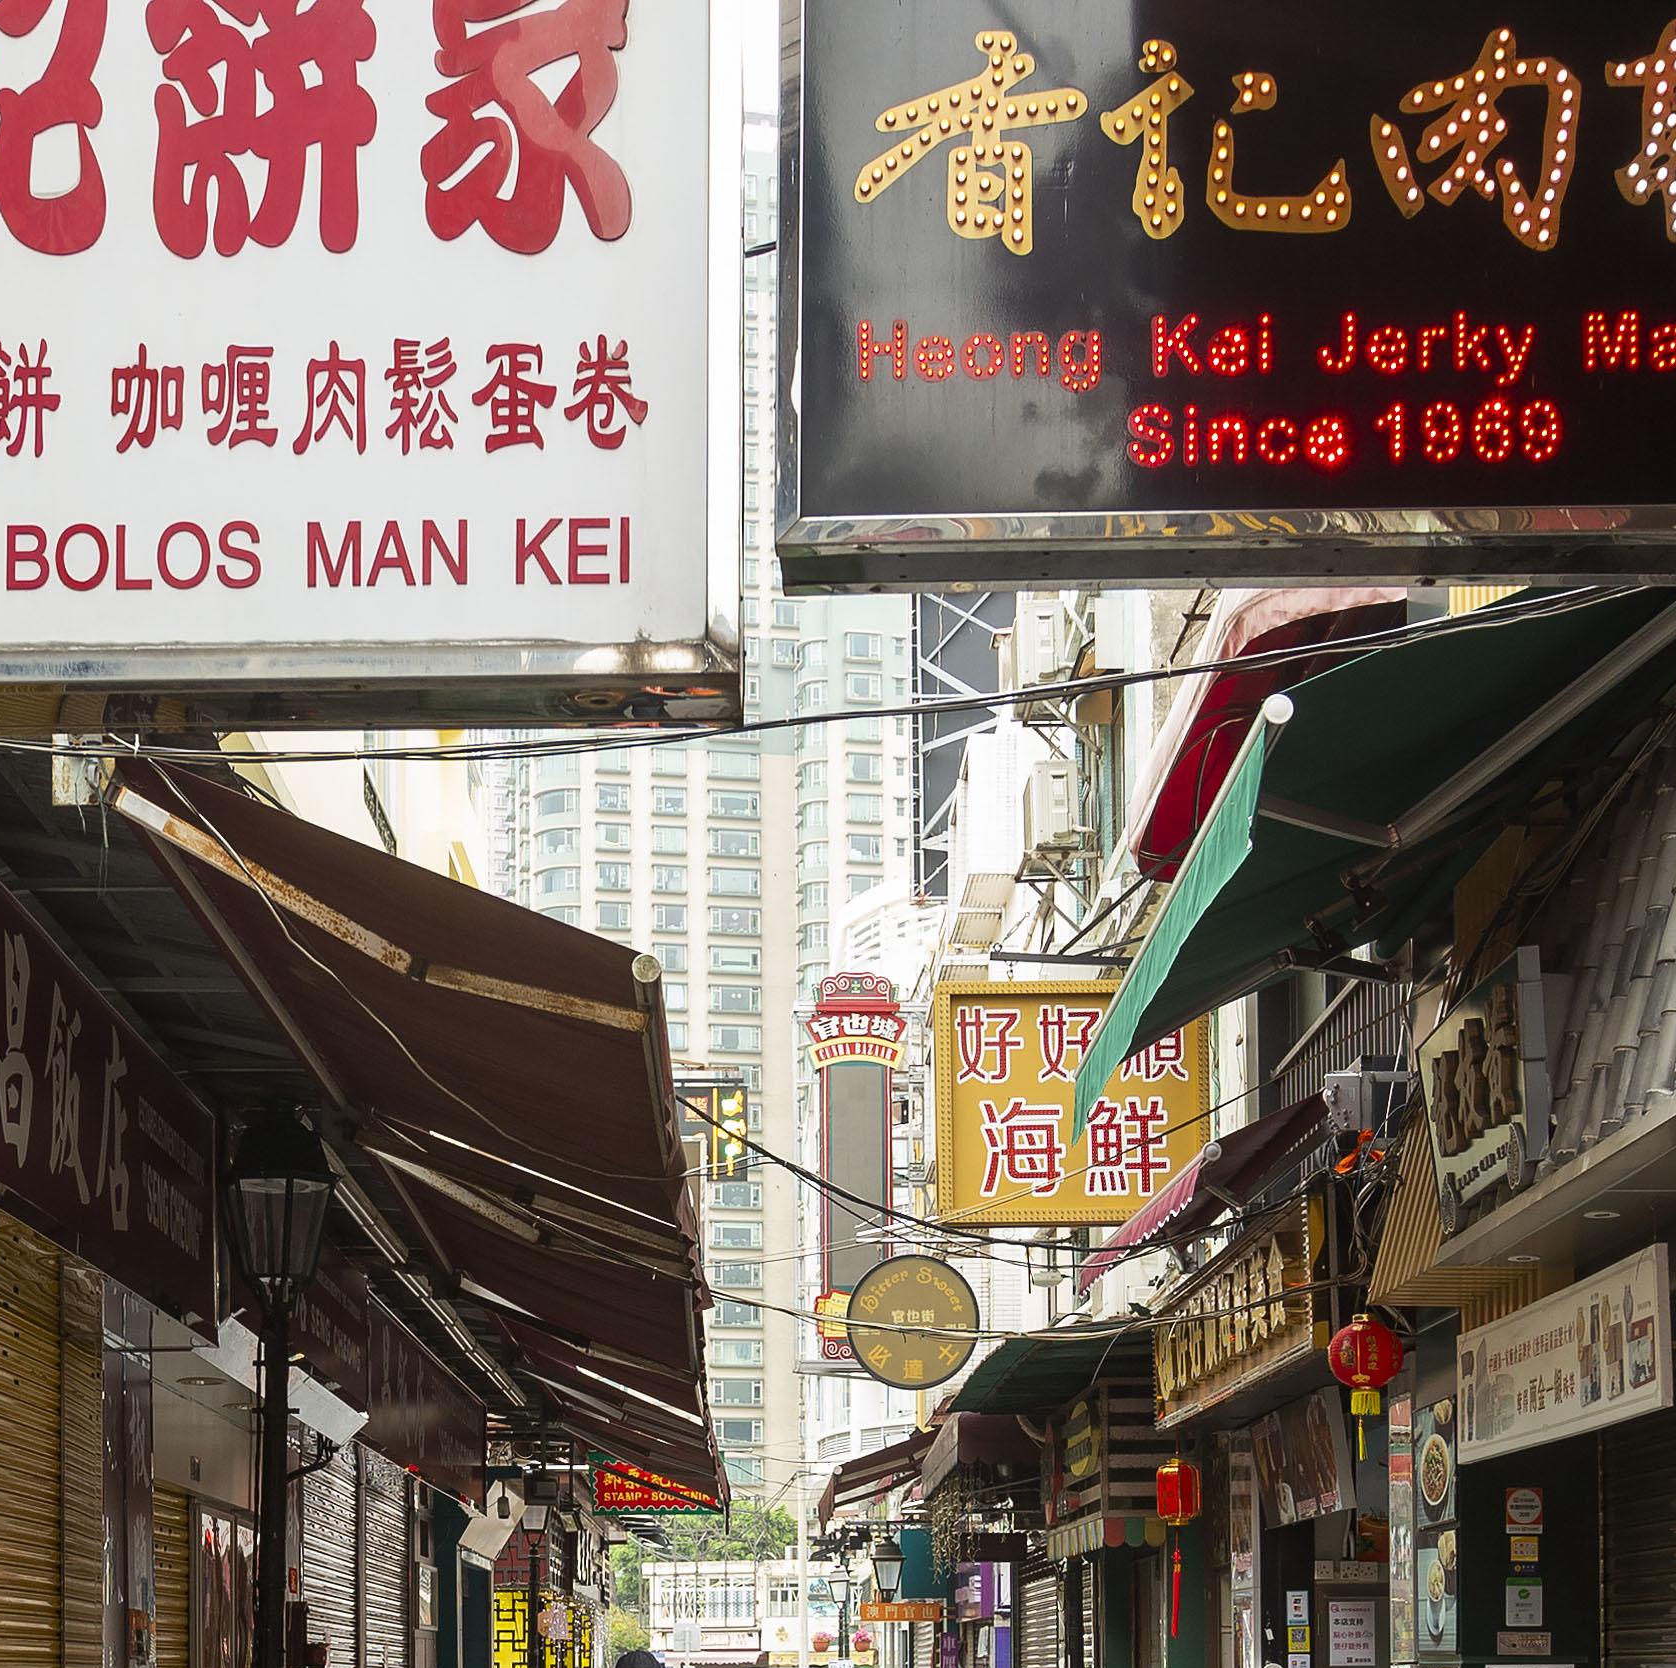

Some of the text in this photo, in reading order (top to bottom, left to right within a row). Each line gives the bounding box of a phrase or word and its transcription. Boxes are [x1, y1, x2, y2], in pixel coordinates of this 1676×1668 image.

[856, 317, 1102, 393] Heong
[1152, 312, 1274, 379] Kei
[1317, 310, 1537, 387] Jerky
[1126, 398, 1564, 469] Since 1969
[7, 520, 263, 591] BOLOS
[306, 519, 467, 587] MAN
[517, 517, 632, 585] KEI
[980, 1097, 1170, 1198] 海鮮
[604, 1492, 641, 1501] STAMP
